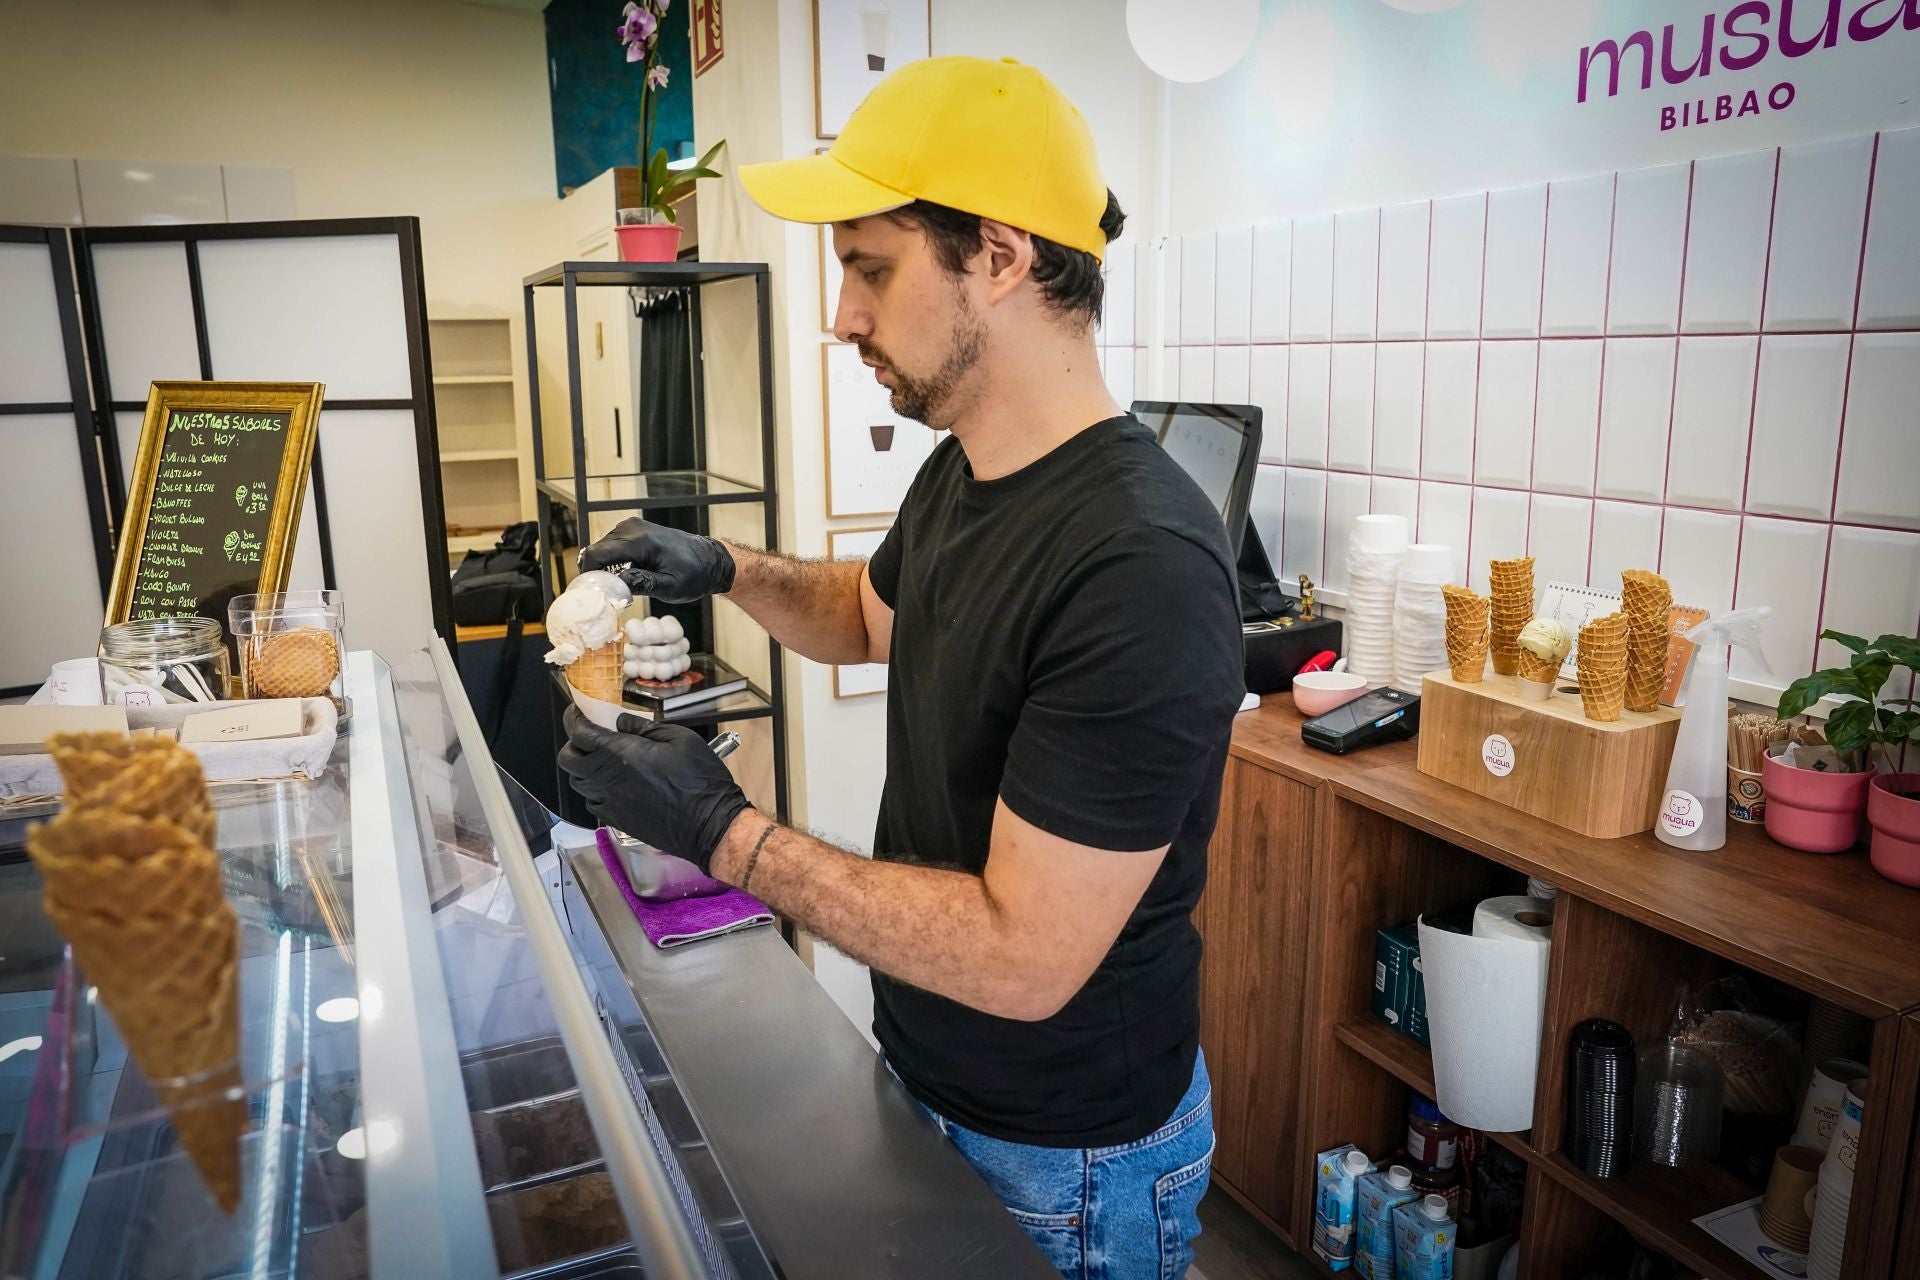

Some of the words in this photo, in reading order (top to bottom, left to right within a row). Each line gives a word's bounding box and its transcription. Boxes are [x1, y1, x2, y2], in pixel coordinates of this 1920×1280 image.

[1577, 0, 1920, 103] musua
[1660, 82, 1796, 131] BILBAO
[169, 413, 230, 432] NUESTROS
[232, 416, 281, 431] SABORES
[190, 433, 205, 446] DE
[213, 432, 240, 447] HOY:
[160, 482, 182, 492] DULCE
[185, 484, 192, 492] DE
[194, 483, 215, 492] LECHE
[156, 497, 191, 508] BANOFFEE
[151, 530, 179, 540] VIOLETA
[143, 568, 169, 578] MANGO
[142, 581, 163, 592] COCO
[166, 581, 191, 593] BOUNTY
[140, 595, 155, 605] RON
[160, 597, 175, 606] CON
[178, 596, 198, 608] PASAS
[1485, 755, 1510, 769] musua
[1662, 812, 1695, 827] musua
